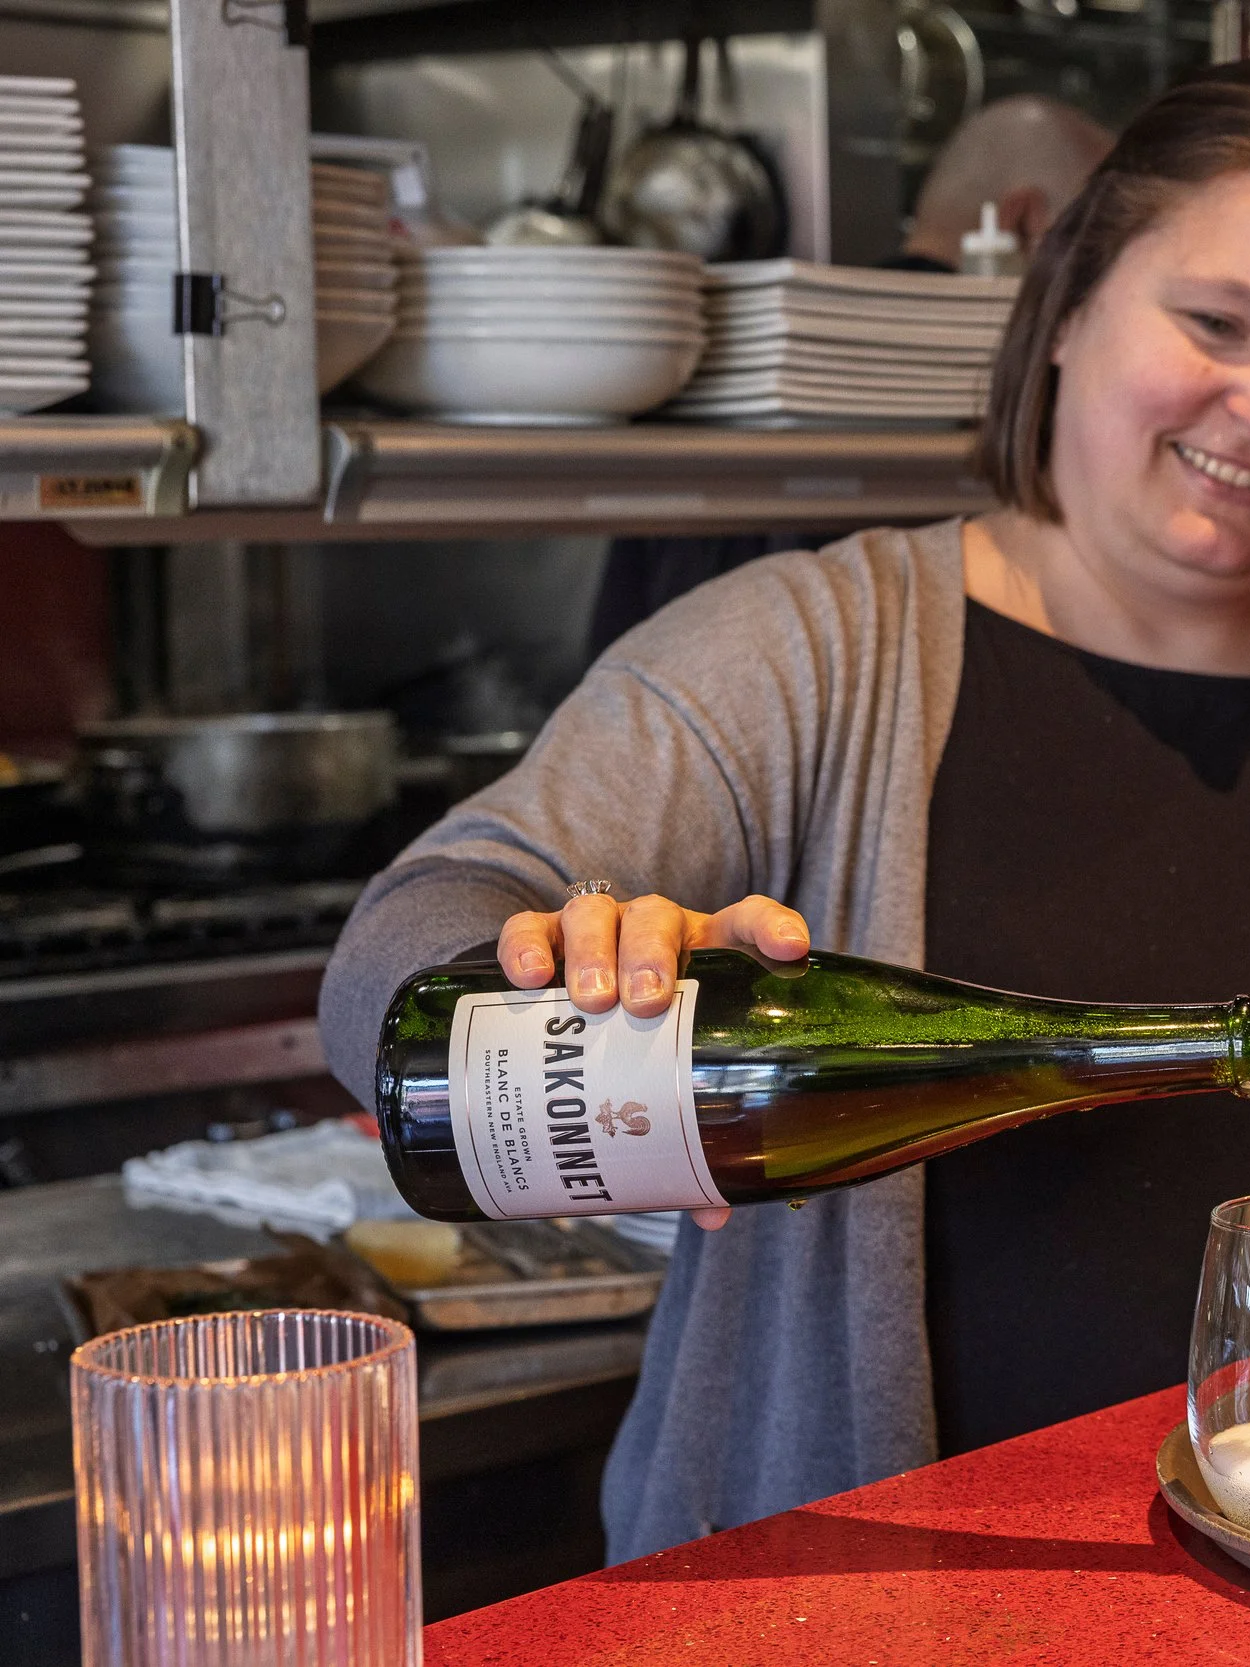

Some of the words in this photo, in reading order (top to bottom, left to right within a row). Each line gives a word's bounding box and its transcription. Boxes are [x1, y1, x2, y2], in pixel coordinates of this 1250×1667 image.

[484, 1049, 493, 1118] SOUTHEASTERN
[497, 1048, 509, 1103] BLANC
[500, 1111, 512, 1132] DE
[514, 1086, 525, 1124] ESTATE
[542, 1015, 613, 1202] SAKONNET
[488, 1121, 497, 1141] NEW
[519, 1125, 532, 1162] GROWN
[493, 1142, 508, 1180] ENGLAND
[504, 1139, 529, 1191] BLANCS
[503, 1180, 513, 1194] AVA
